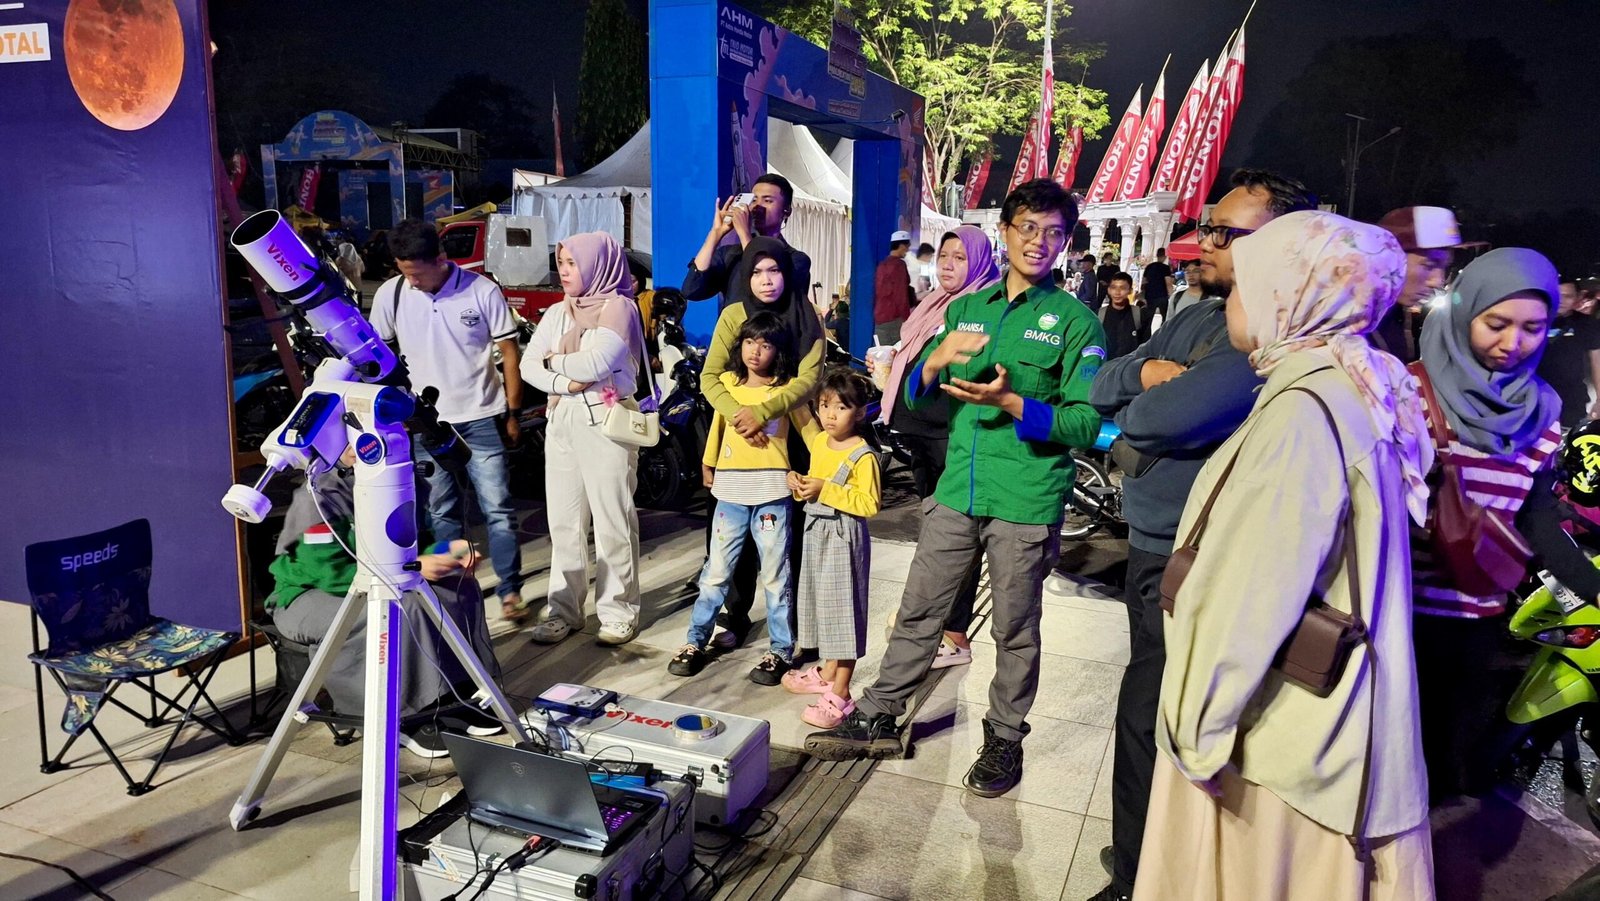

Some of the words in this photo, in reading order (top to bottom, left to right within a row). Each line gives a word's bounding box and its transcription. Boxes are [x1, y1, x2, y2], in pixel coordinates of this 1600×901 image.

[1013, 141, 1034, 190] HON
[1157, 118, 1189, 192] HOND
[1184, 96, 1228, 201] HONDA
[299, 169, 315, 210] HON
[1090, 138, 1126, 203] HOND
[267, 242, 299, 281] Vixen
[957, 321, 985, 333] KHANSA
[1024, 329, 1061, 346] BMKG
[379, 632, 388, 665] Vixen
